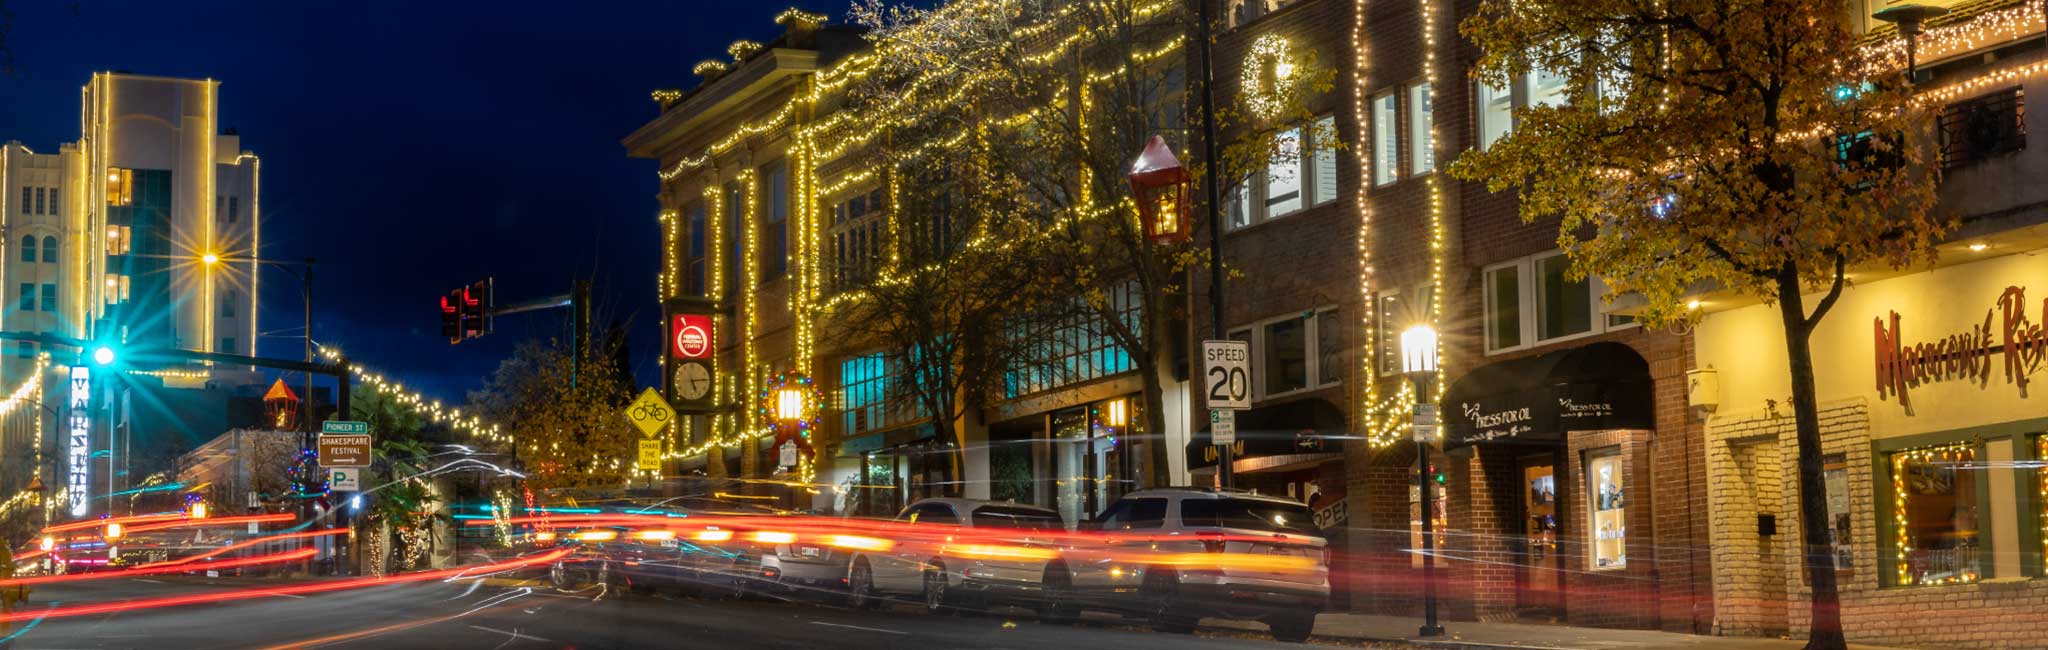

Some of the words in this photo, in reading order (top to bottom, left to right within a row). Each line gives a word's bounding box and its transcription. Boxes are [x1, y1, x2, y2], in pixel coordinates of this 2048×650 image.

[1207, 348, 1245, 361] SPEED
[1874, 309, 1994, 412] Macaroni's
[1208, 366, 1247, 401] 20
[1501, 410, 1517, 424] FOR
[71, 377, 88, 511] VARSITY
[321, 437, 368, 446] SHAKESPEARE
[641, 442, 659, 450] SHARE
[331, 447, 361, 455] FESTIVAL
